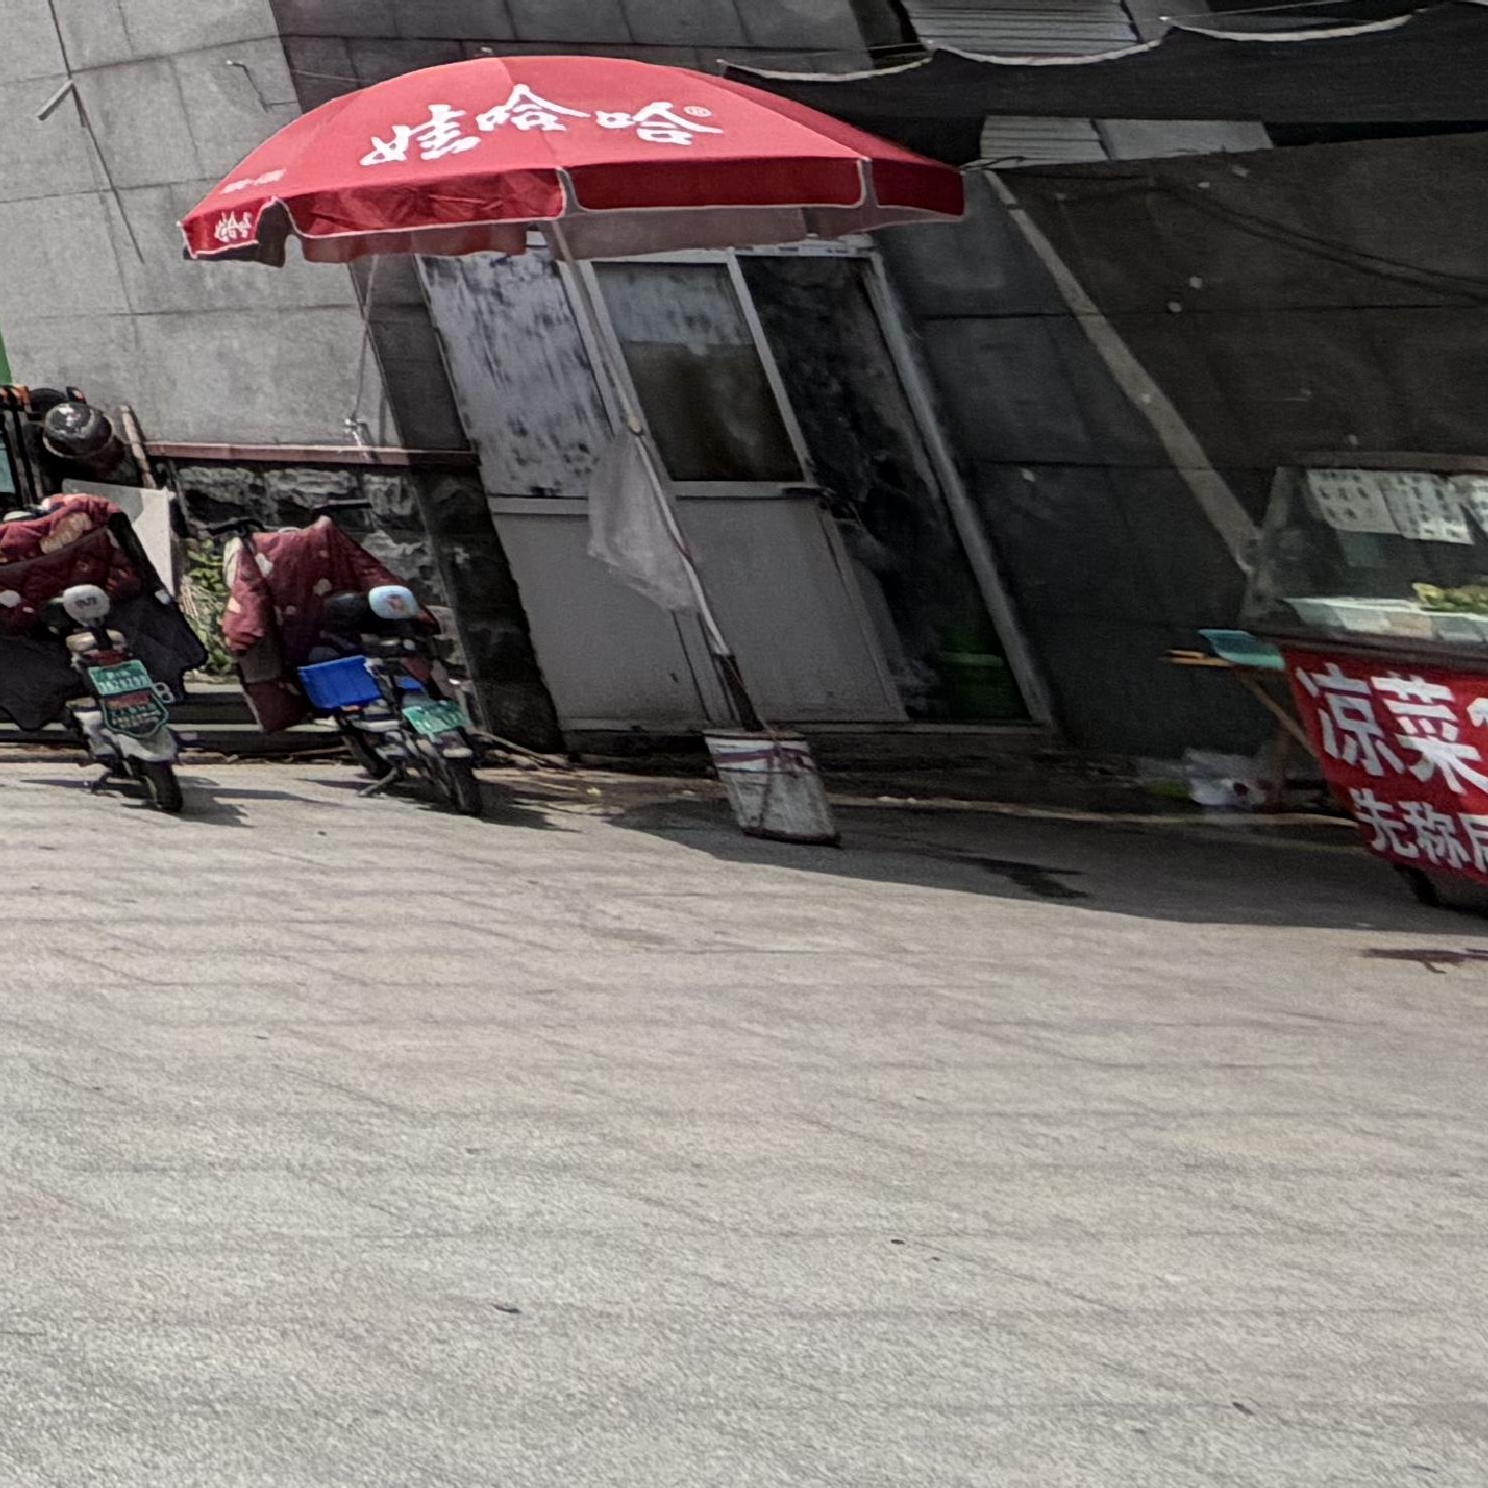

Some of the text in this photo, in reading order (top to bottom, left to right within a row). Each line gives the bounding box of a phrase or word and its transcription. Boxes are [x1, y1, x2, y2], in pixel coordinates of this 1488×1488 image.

[359, 83, 724, 166] 娃哈哈
[1296, 661, 1488, 795] 凉菜
